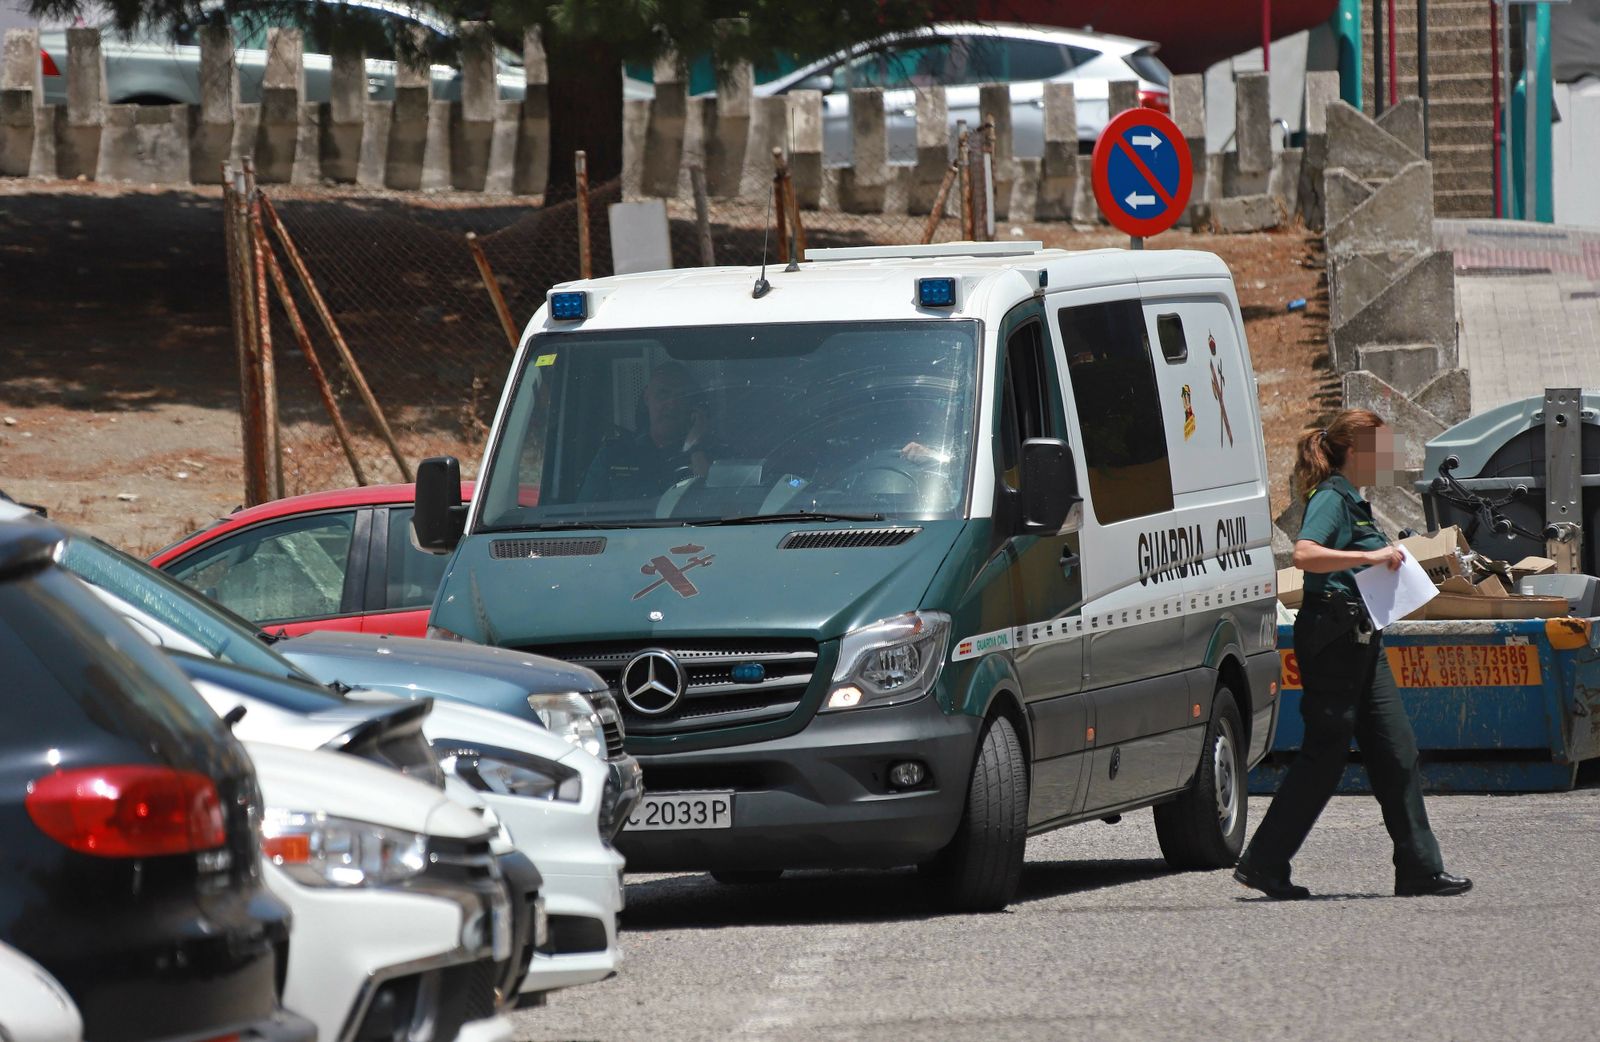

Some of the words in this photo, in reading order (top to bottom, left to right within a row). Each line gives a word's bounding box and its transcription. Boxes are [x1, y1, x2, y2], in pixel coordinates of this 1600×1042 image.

[1138, 524, 1207, 586] GUARDIA
[1216, 516, 1252, 571] CIVIL
[976, 636, 997, 651] GUARDIA
[997, 633, 1008, 646] CIVIL
[1436, 645, 1528, 667] 956.573586
[1400, 666, 1437, 687] FAX.
[1439, 665, 1529, 686] 956.573197
